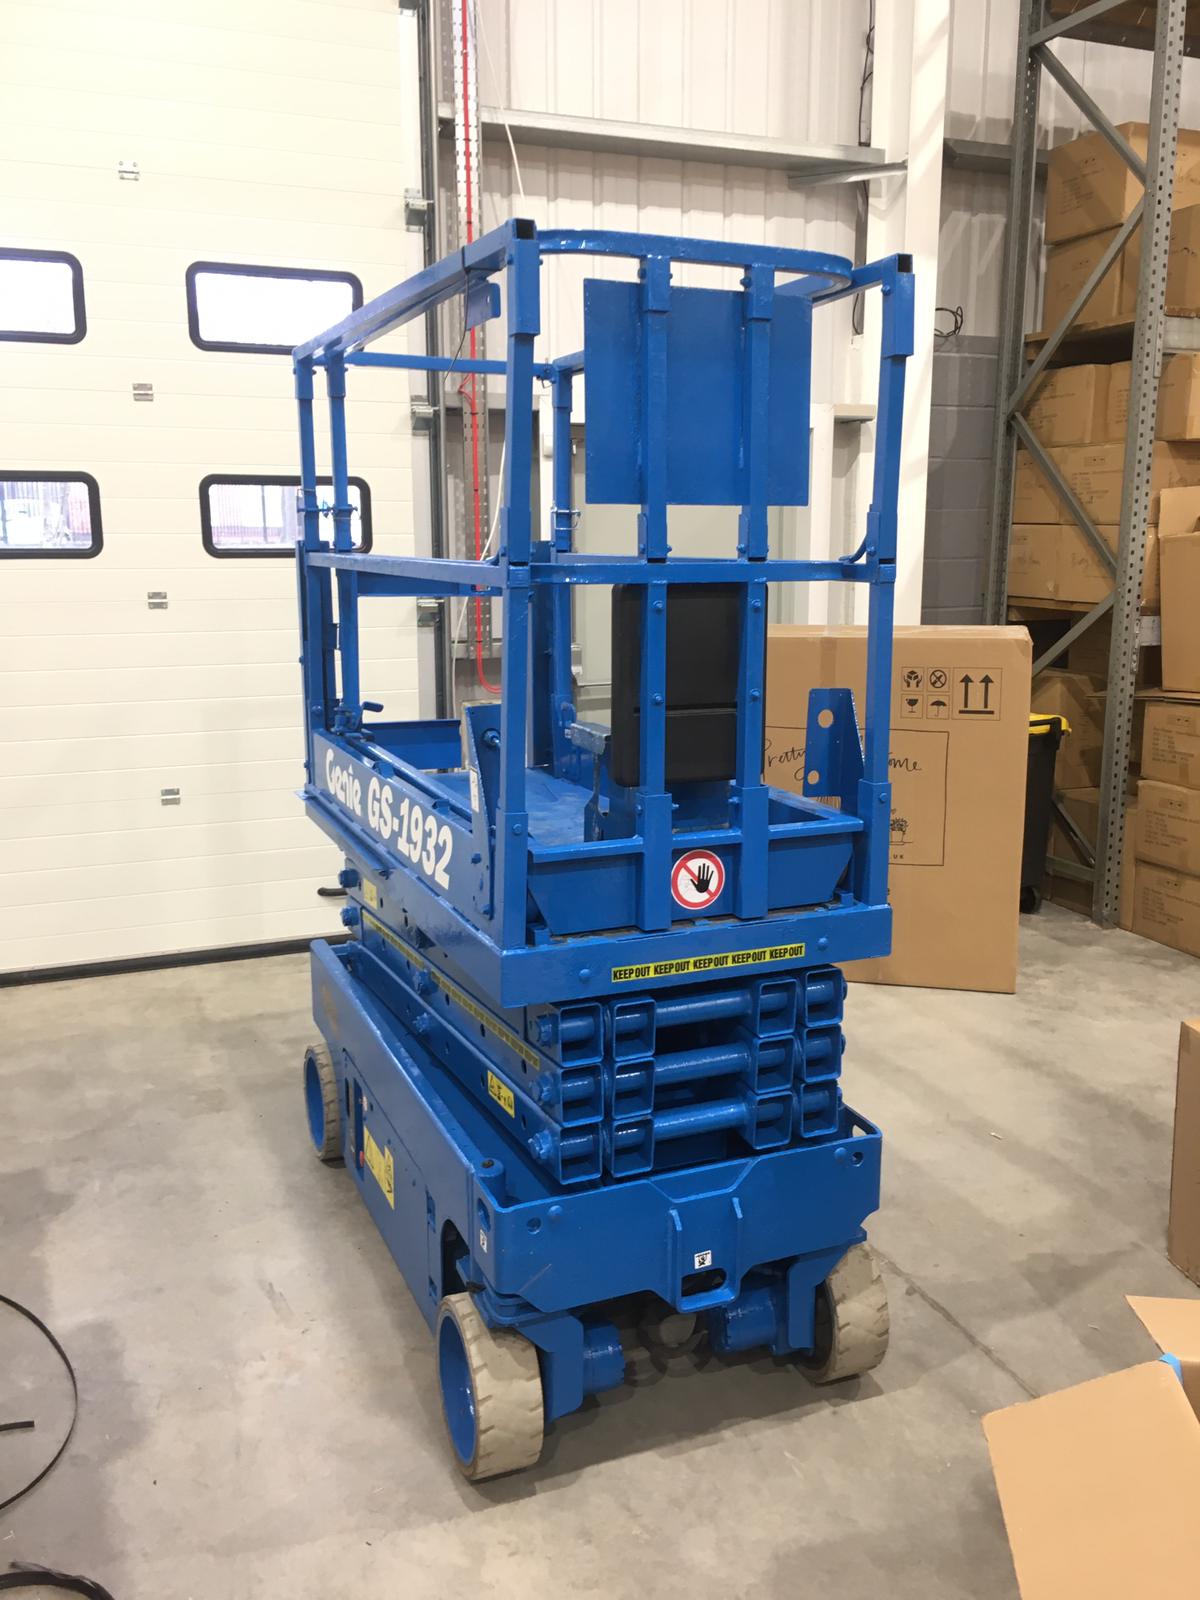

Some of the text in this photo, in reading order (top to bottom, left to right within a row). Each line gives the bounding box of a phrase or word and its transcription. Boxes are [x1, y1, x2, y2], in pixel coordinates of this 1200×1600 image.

[888, 753, 922, 772] ome
[326, 748, 361, 817] Genie
[368, 777, 453, 890] GS-1932
[613, 945, 803, 981] KEEP OUT KEEP OUT KEEP OUT KEEP OUT KEEP OUT
